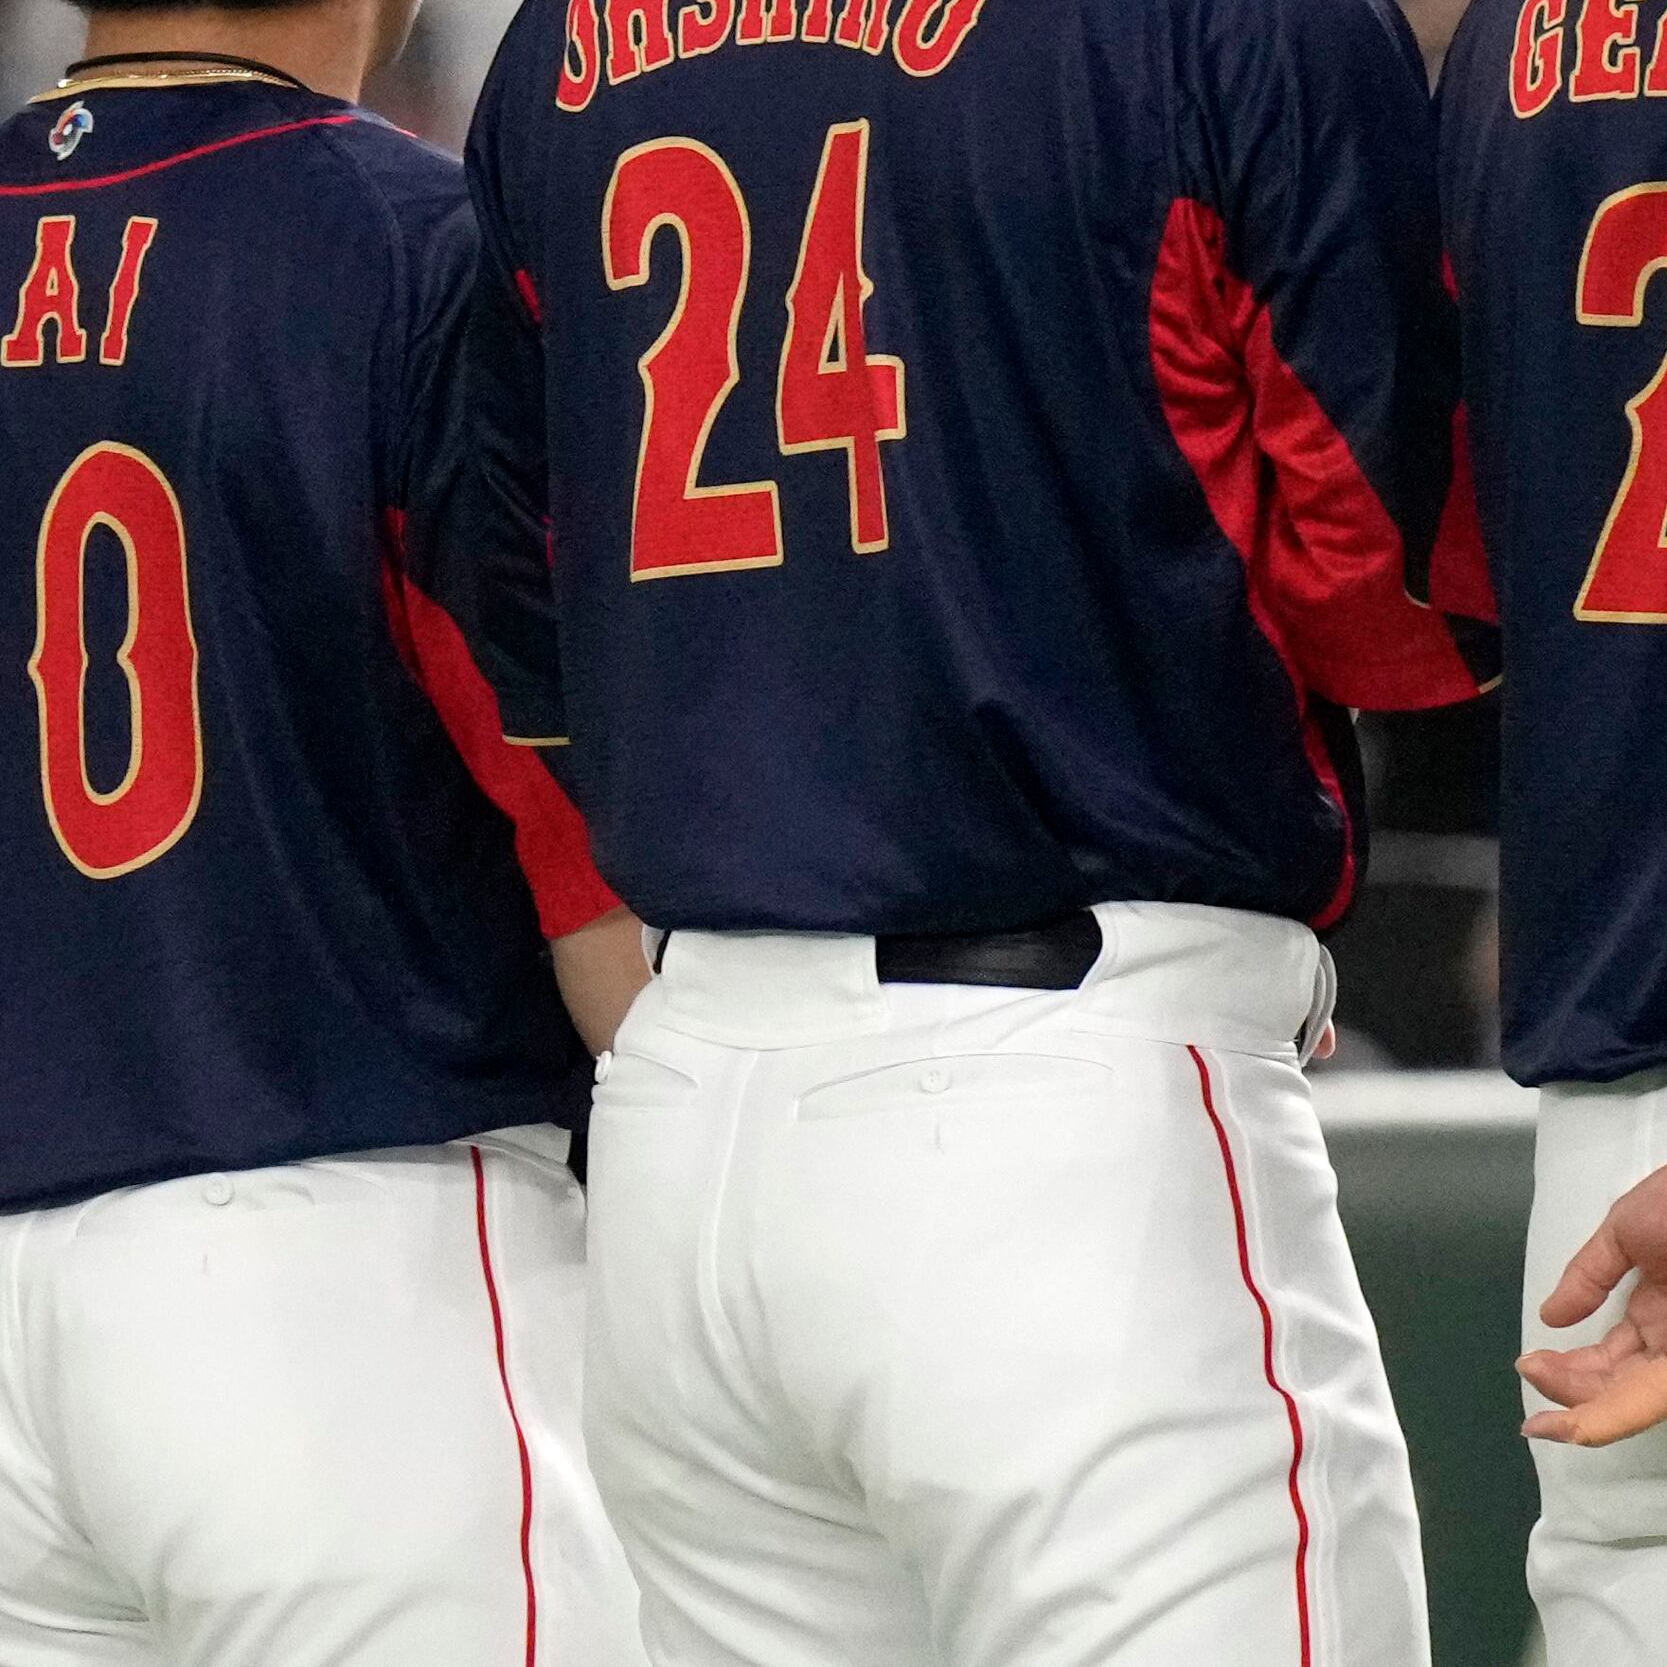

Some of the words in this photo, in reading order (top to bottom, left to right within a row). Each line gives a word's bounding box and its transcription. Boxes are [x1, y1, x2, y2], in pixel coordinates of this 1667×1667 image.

[0, 214, 159, 367] AI
[601, 118, 906, 583] 24
[26, 439, 204, 881] 0
